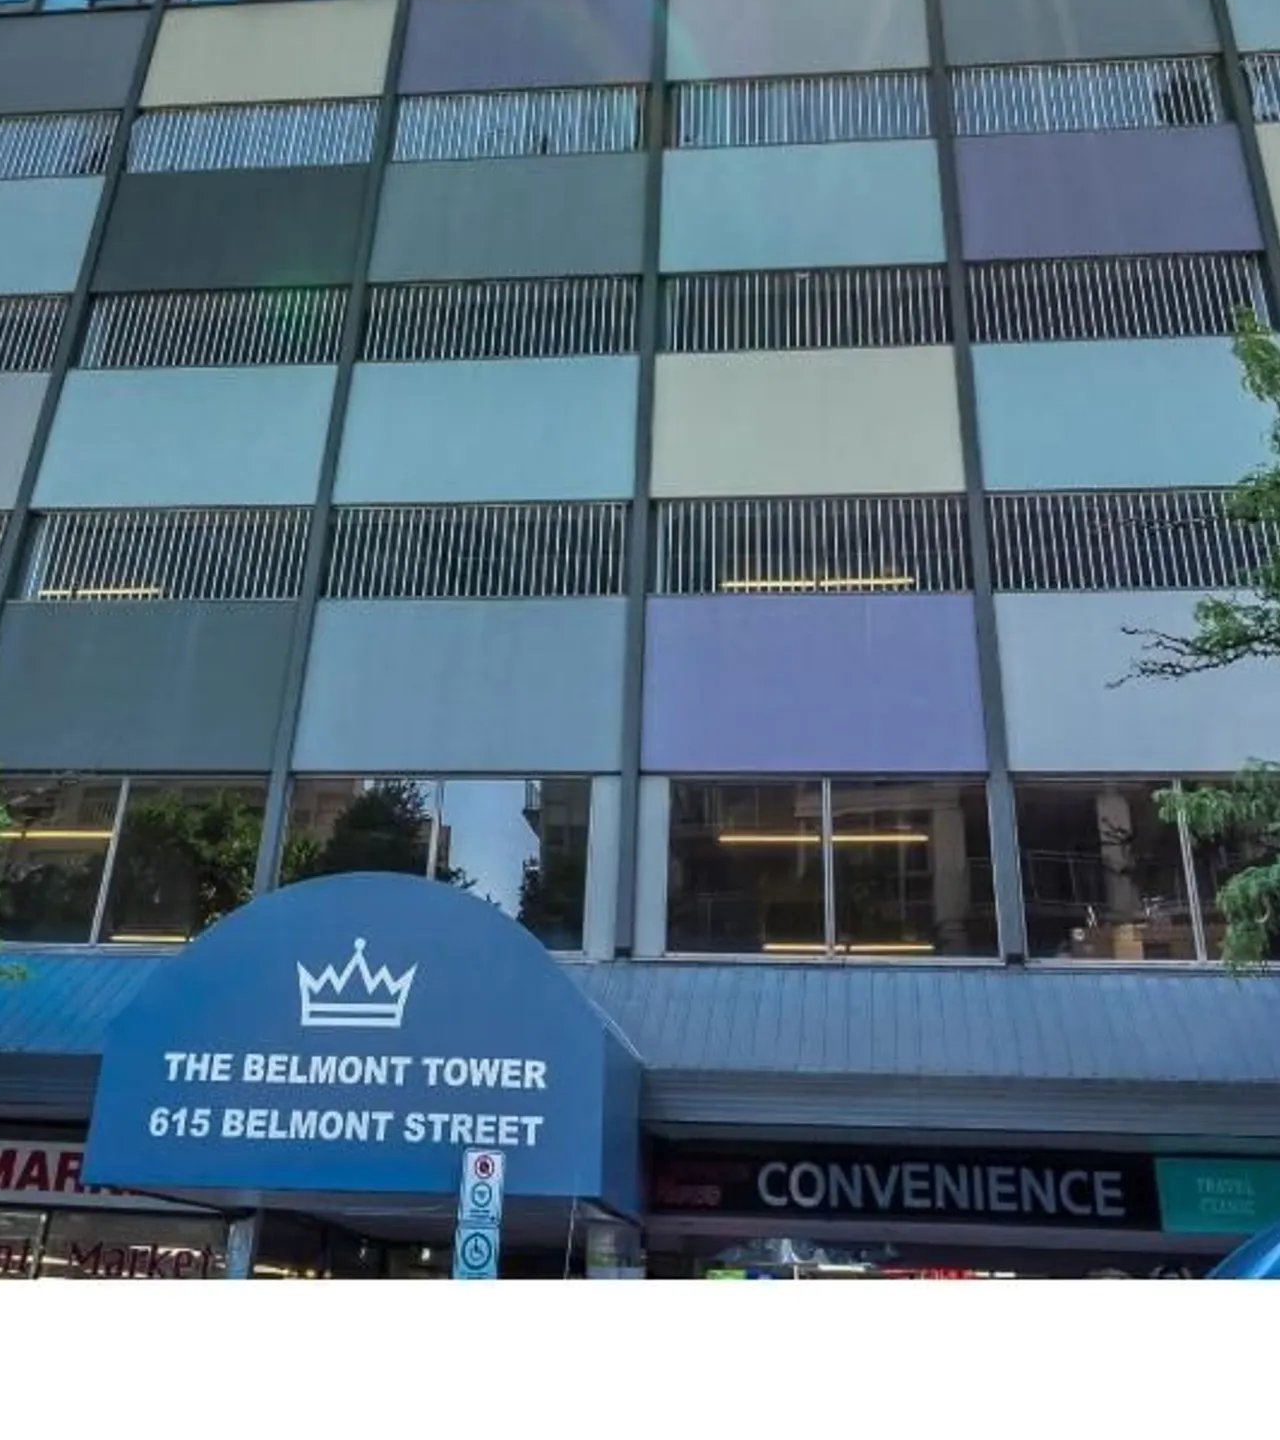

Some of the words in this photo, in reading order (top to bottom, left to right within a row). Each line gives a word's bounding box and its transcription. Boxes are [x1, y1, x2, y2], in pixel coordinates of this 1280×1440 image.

[163, 1052, 232, 1082] THE
[242, 1054, 412, 1086] BELMONT
[424, 1058, 548, 1090] TOWER
[149, 1108, 210, 1137] 615
[221, 1109, 394, 1142] BELMONT
[403, 1114, 544, 1147] STREET
[757, 1161, 1126, 1217] CONVENIENCE
